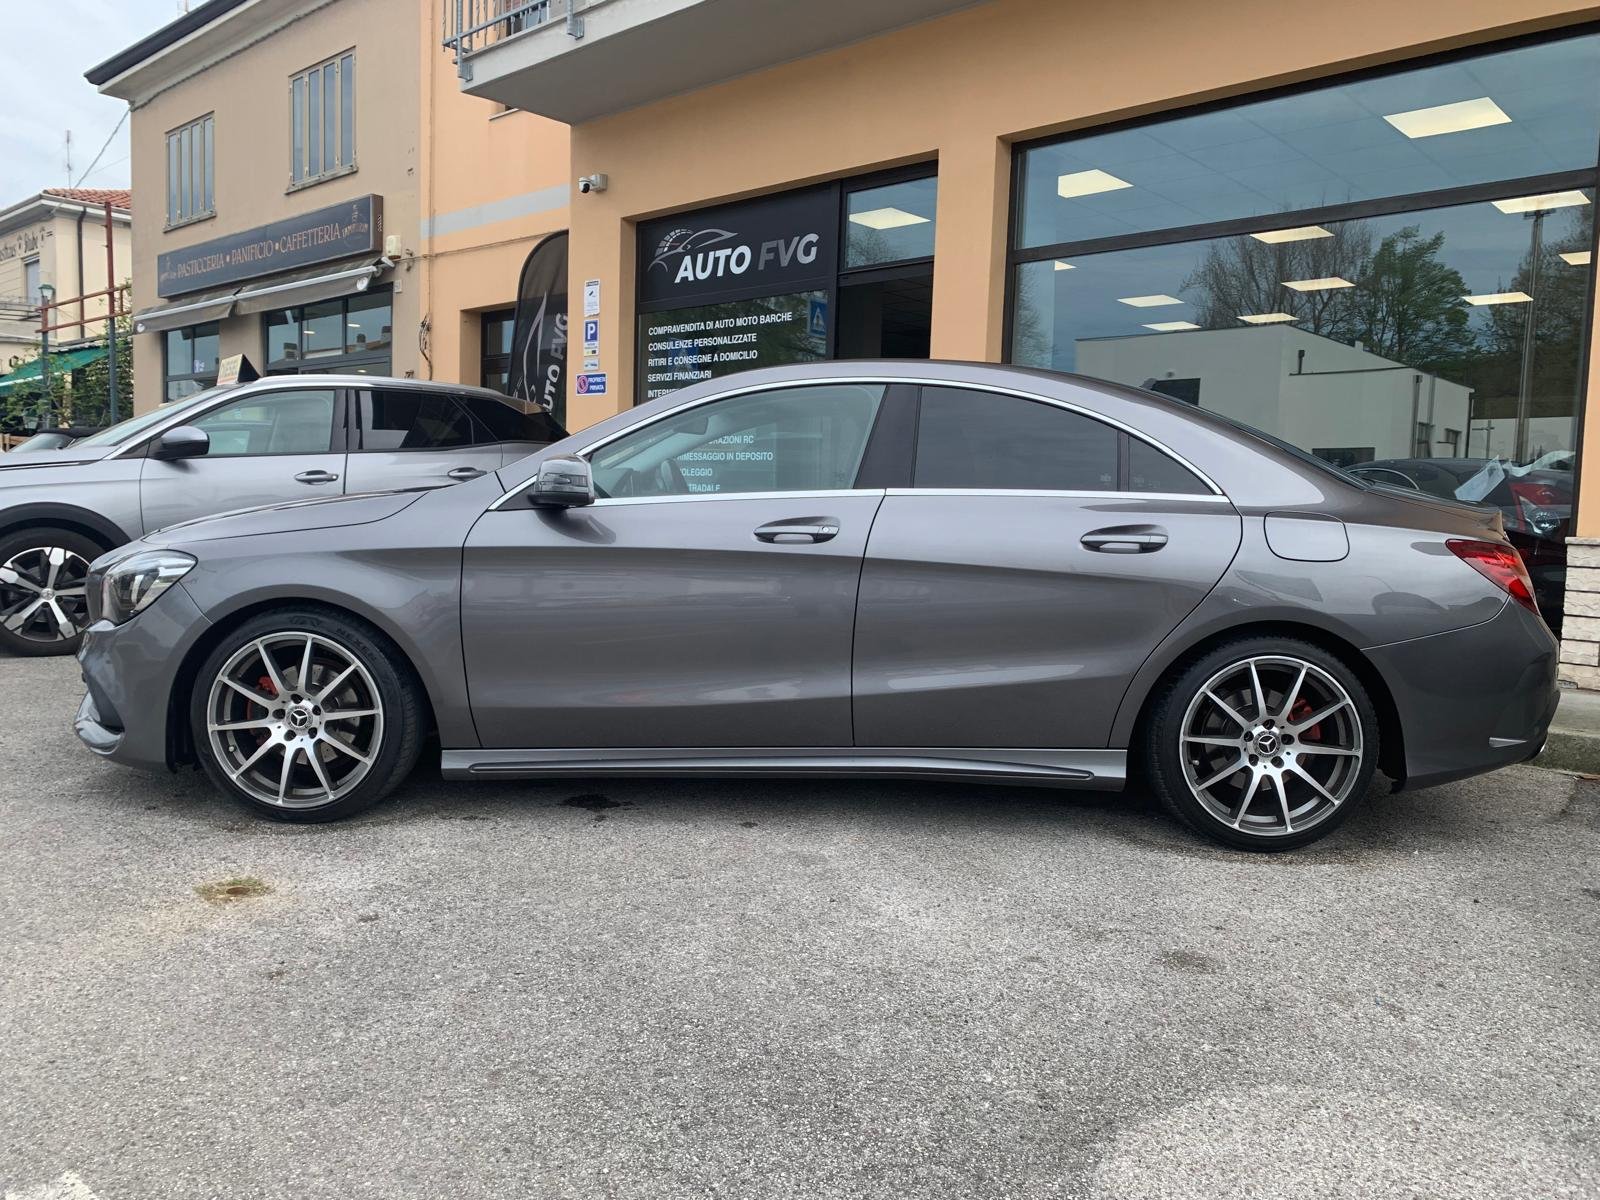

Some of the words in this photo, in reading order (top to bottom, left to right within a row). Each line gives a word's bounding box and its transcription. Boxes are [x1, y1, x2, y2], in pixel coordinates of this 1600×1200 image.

[177, 253, 225, 278] PASTICCERIA
[231, 240, 274, 265] PANIFICIO
[279, 223, 341, 253] CAFFETTERIA
[674, 245, 752, 283] AUTO
[758, 233, 820, 270] FVG
[648, 322, 705, 336] COMPRAVENDITA
[706, 321, 714, 330] DI
[714, 318, 735, 329] AUTO
[736, 316, 759, 327] MOTO
[760, 312, 793, 324] BARCHE
[648, 339, 693, 351] CONSULENZE
[694, 333, 757, 347] PERSONALIZZATE
[648, 358, 667, 366] RITIRI
[668, 357, 673, 365] E
[674, 353, 712, 365] CONSEGNE
[713, 353, 719, 362] A
[720, 350, 758, 362] DOMICILIO
[647, 372, 673, 382] SERVIZI
[674, 370, 712, 380] FINANZIARI
[542, 364, 561, 415] UTO
[743, 435, 754, 444] RC
[726, 452, 734, 460] IN
[735, 452, 774, 460] DEPOSITO
[680, 468, 713, 477] OLEGGIO
